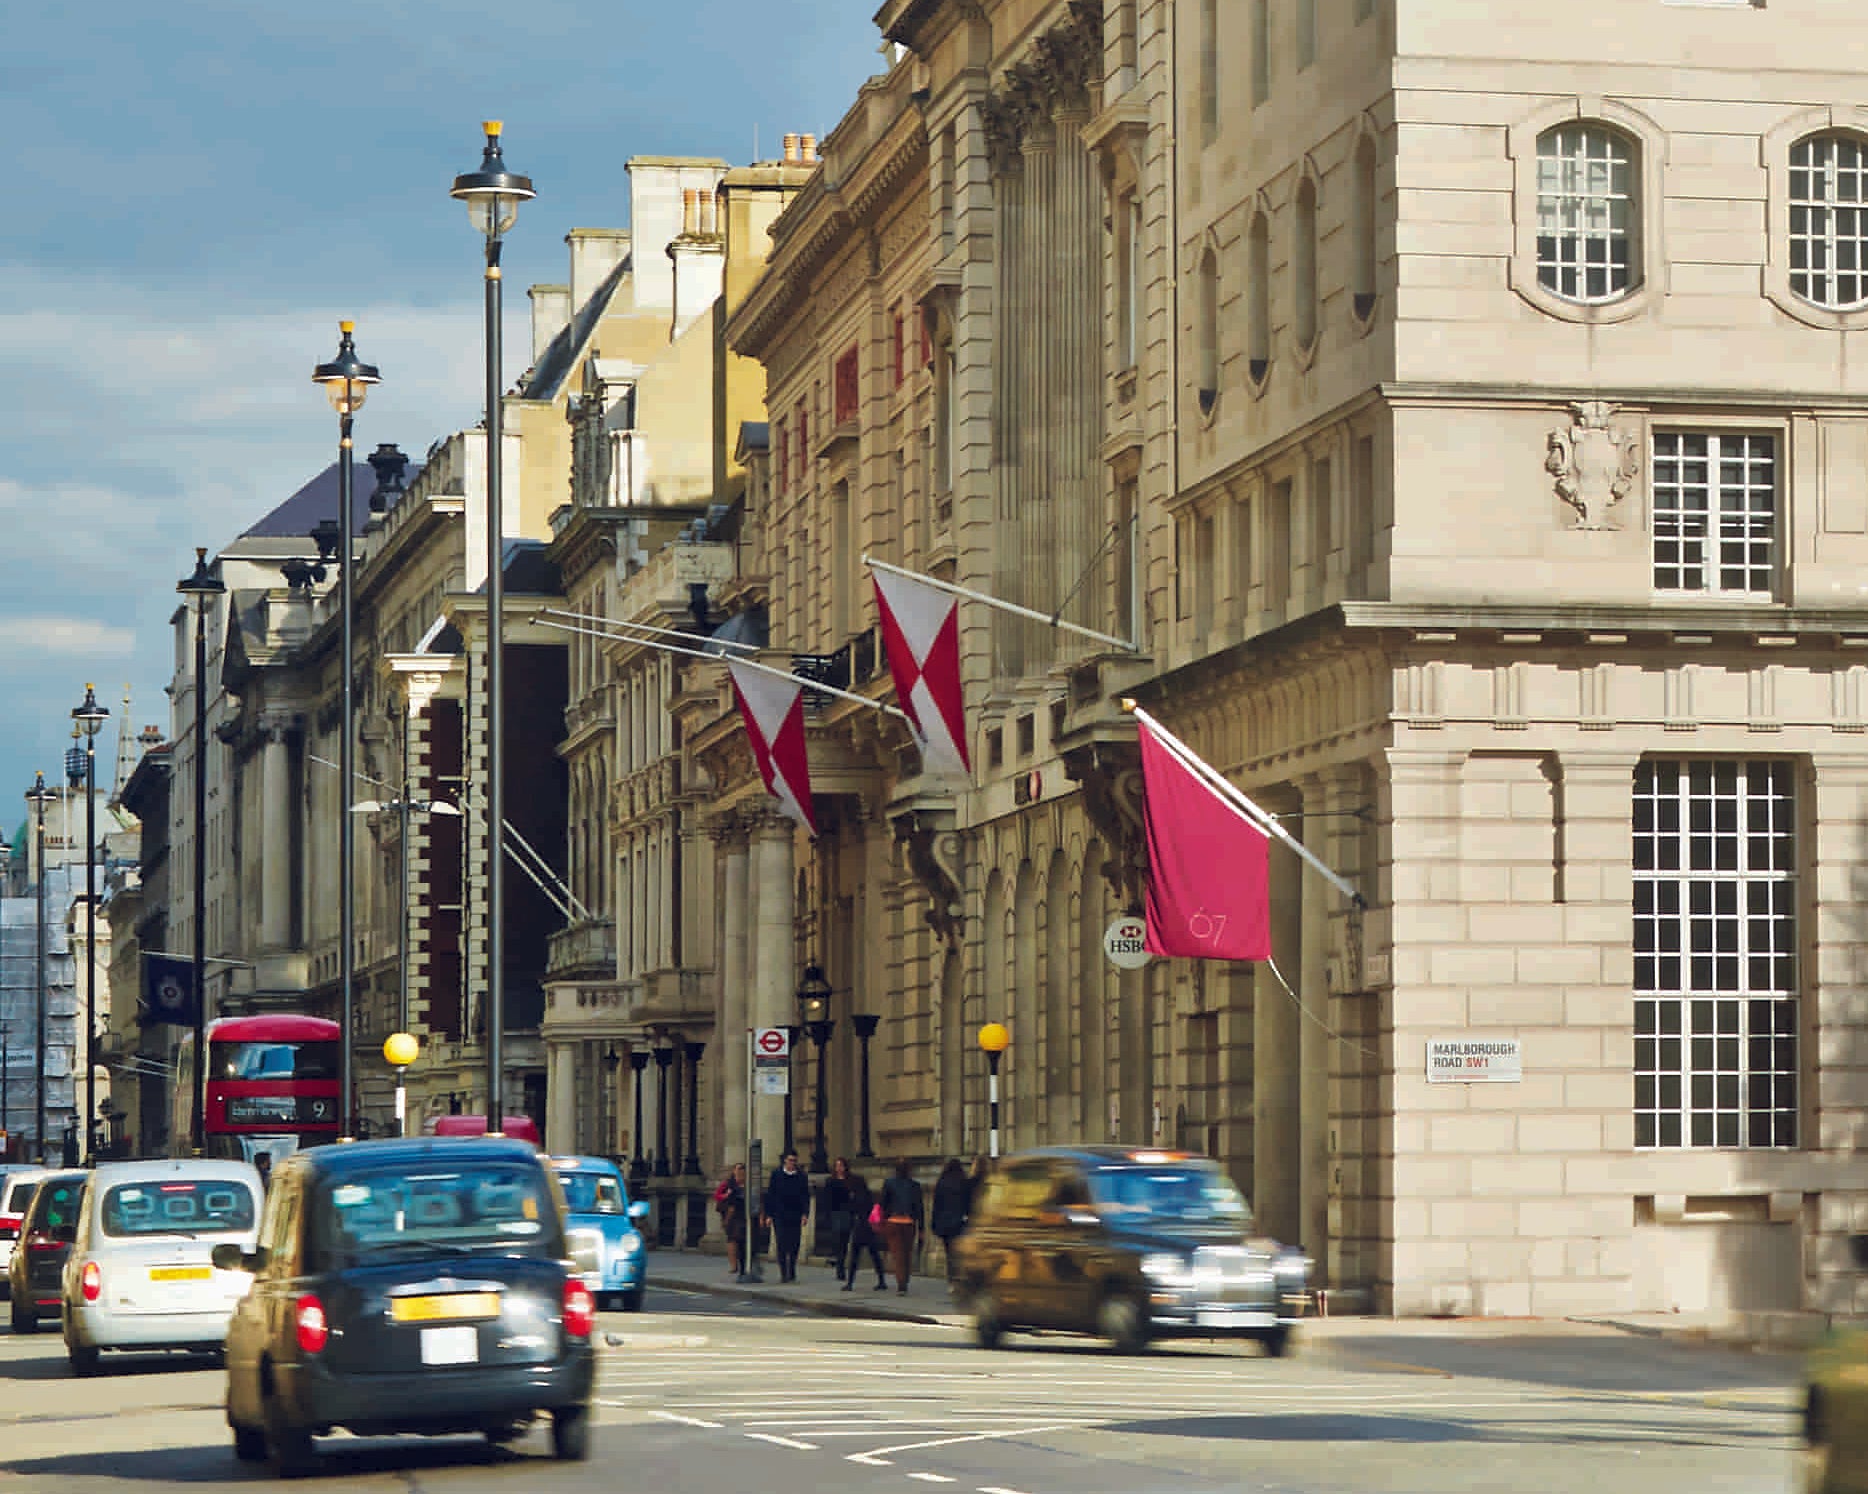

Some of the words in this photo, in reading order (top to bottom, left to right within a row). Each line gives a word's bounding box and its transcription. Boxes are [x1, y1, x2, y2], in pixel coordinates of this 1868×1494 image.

[1433, 1043, 1515, 1055] MARLBOROUGH
[1433, 1056, 1462, 1067] ROAD
[1466, 1056, 1489, 1067] SW1
[312, 1100, 325, 1119] 9
